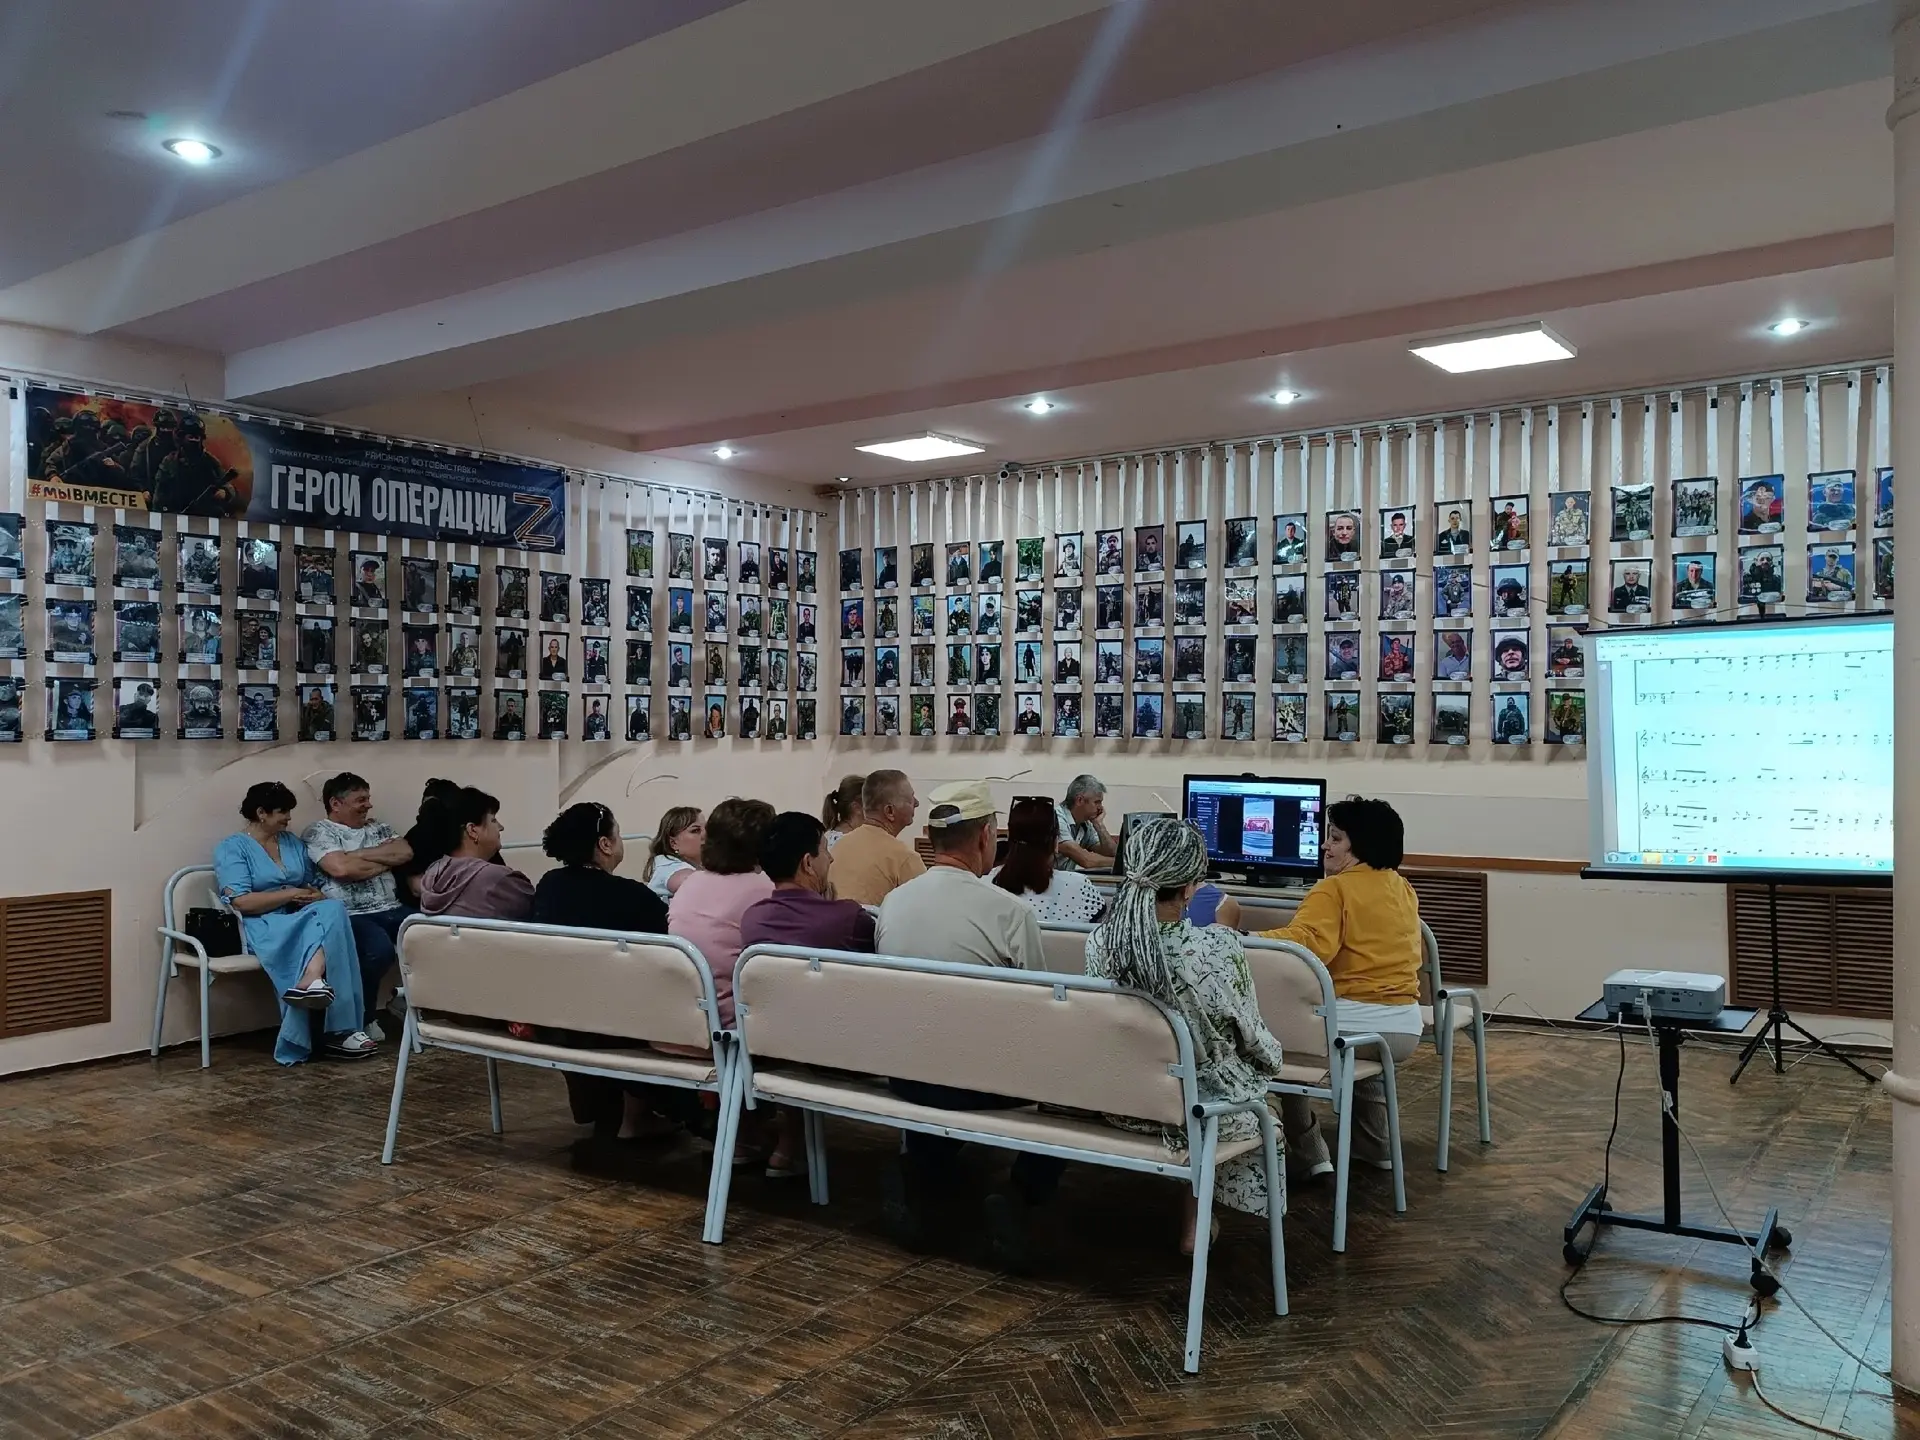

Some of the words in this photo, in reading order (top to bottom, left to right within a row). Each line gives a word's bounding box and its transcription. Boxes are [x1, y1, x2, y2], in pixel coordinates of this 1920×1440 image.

[410, 458, 477, 474] ФОТОВЫСТАВКА
[31, 483, 138, 508] #МЫВМЕСТЕ
[271, 464, 361, 518] ГЕРОИ
[372, 477, 507, 537] ОПЕРАЦИИ
[513, 492, 557, 549] Z
